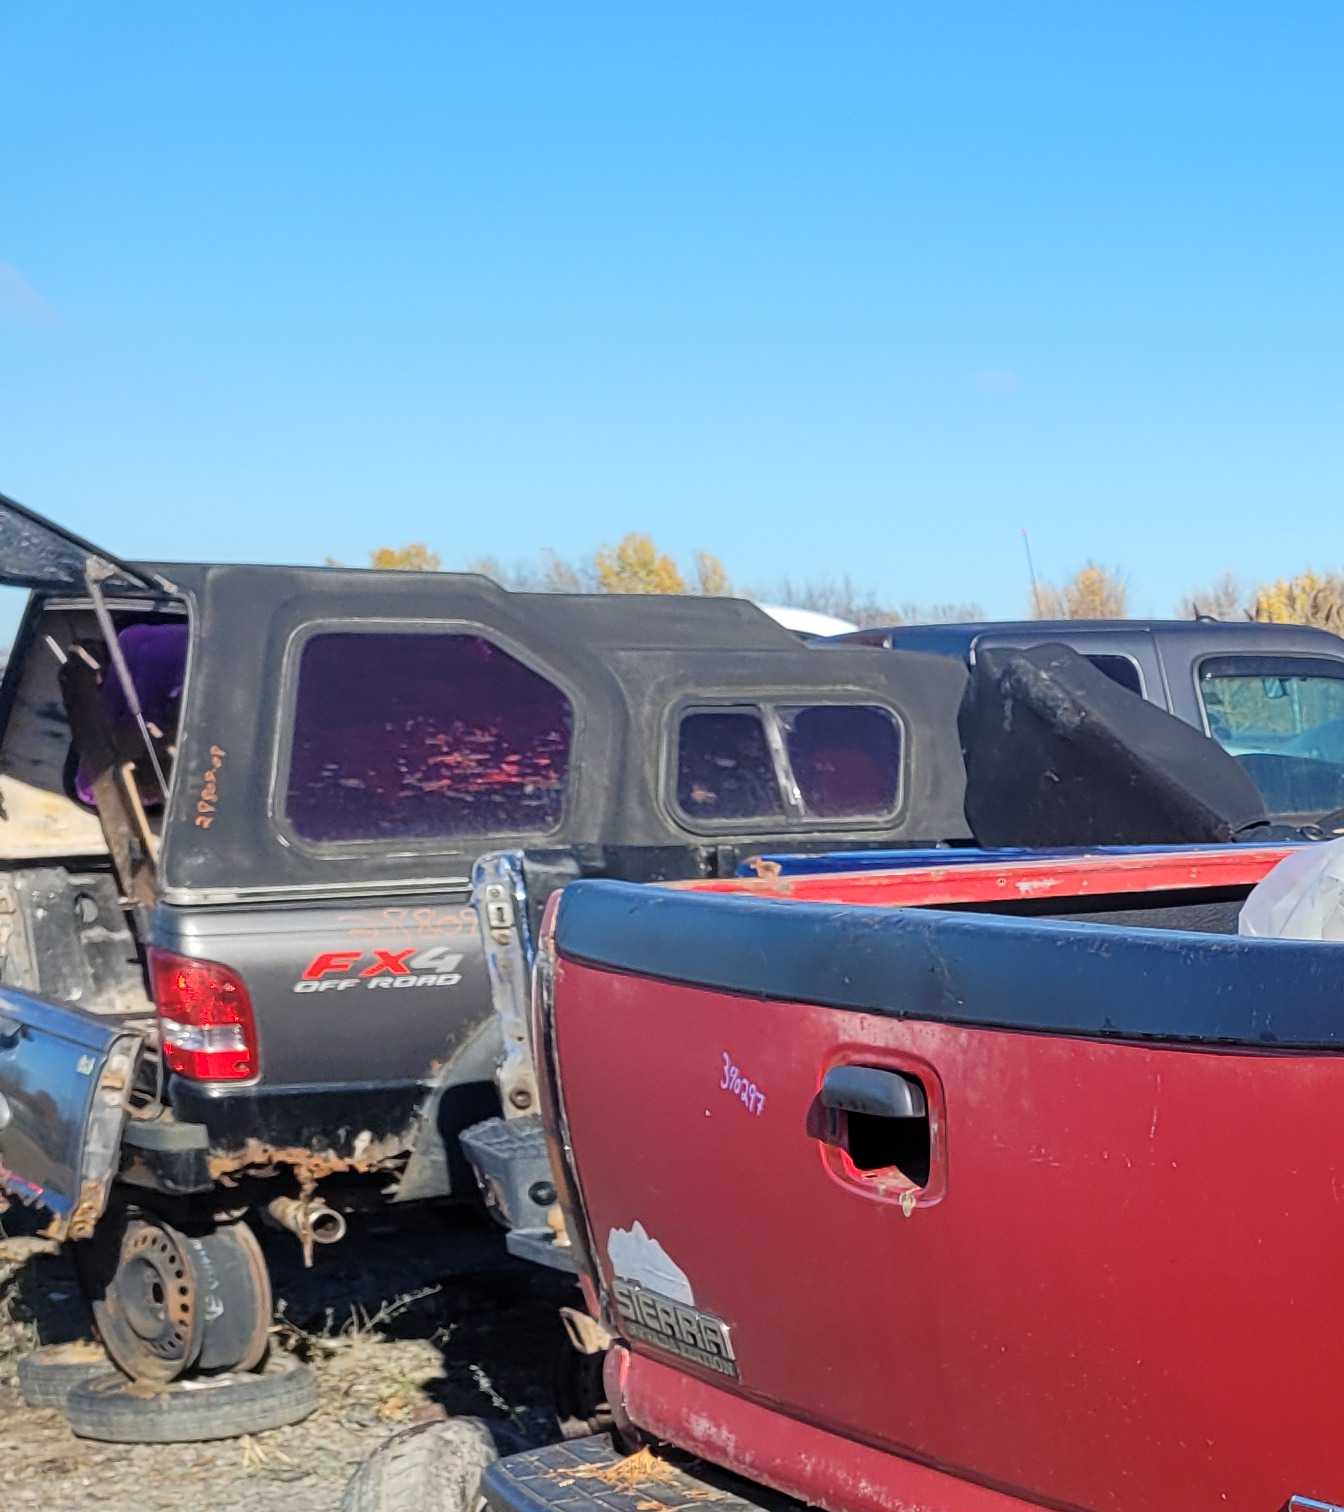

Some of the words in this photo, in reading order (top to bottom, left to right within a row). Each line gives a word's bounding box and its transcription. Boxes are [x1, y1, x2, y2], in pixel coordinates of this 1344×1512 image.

[303, 947, 463, 981] FX4
[294, 978, 361, 993] OFF
[368, 973, 462, 989] ROAD
[615, 1287, 737, 1361] SIERRA
